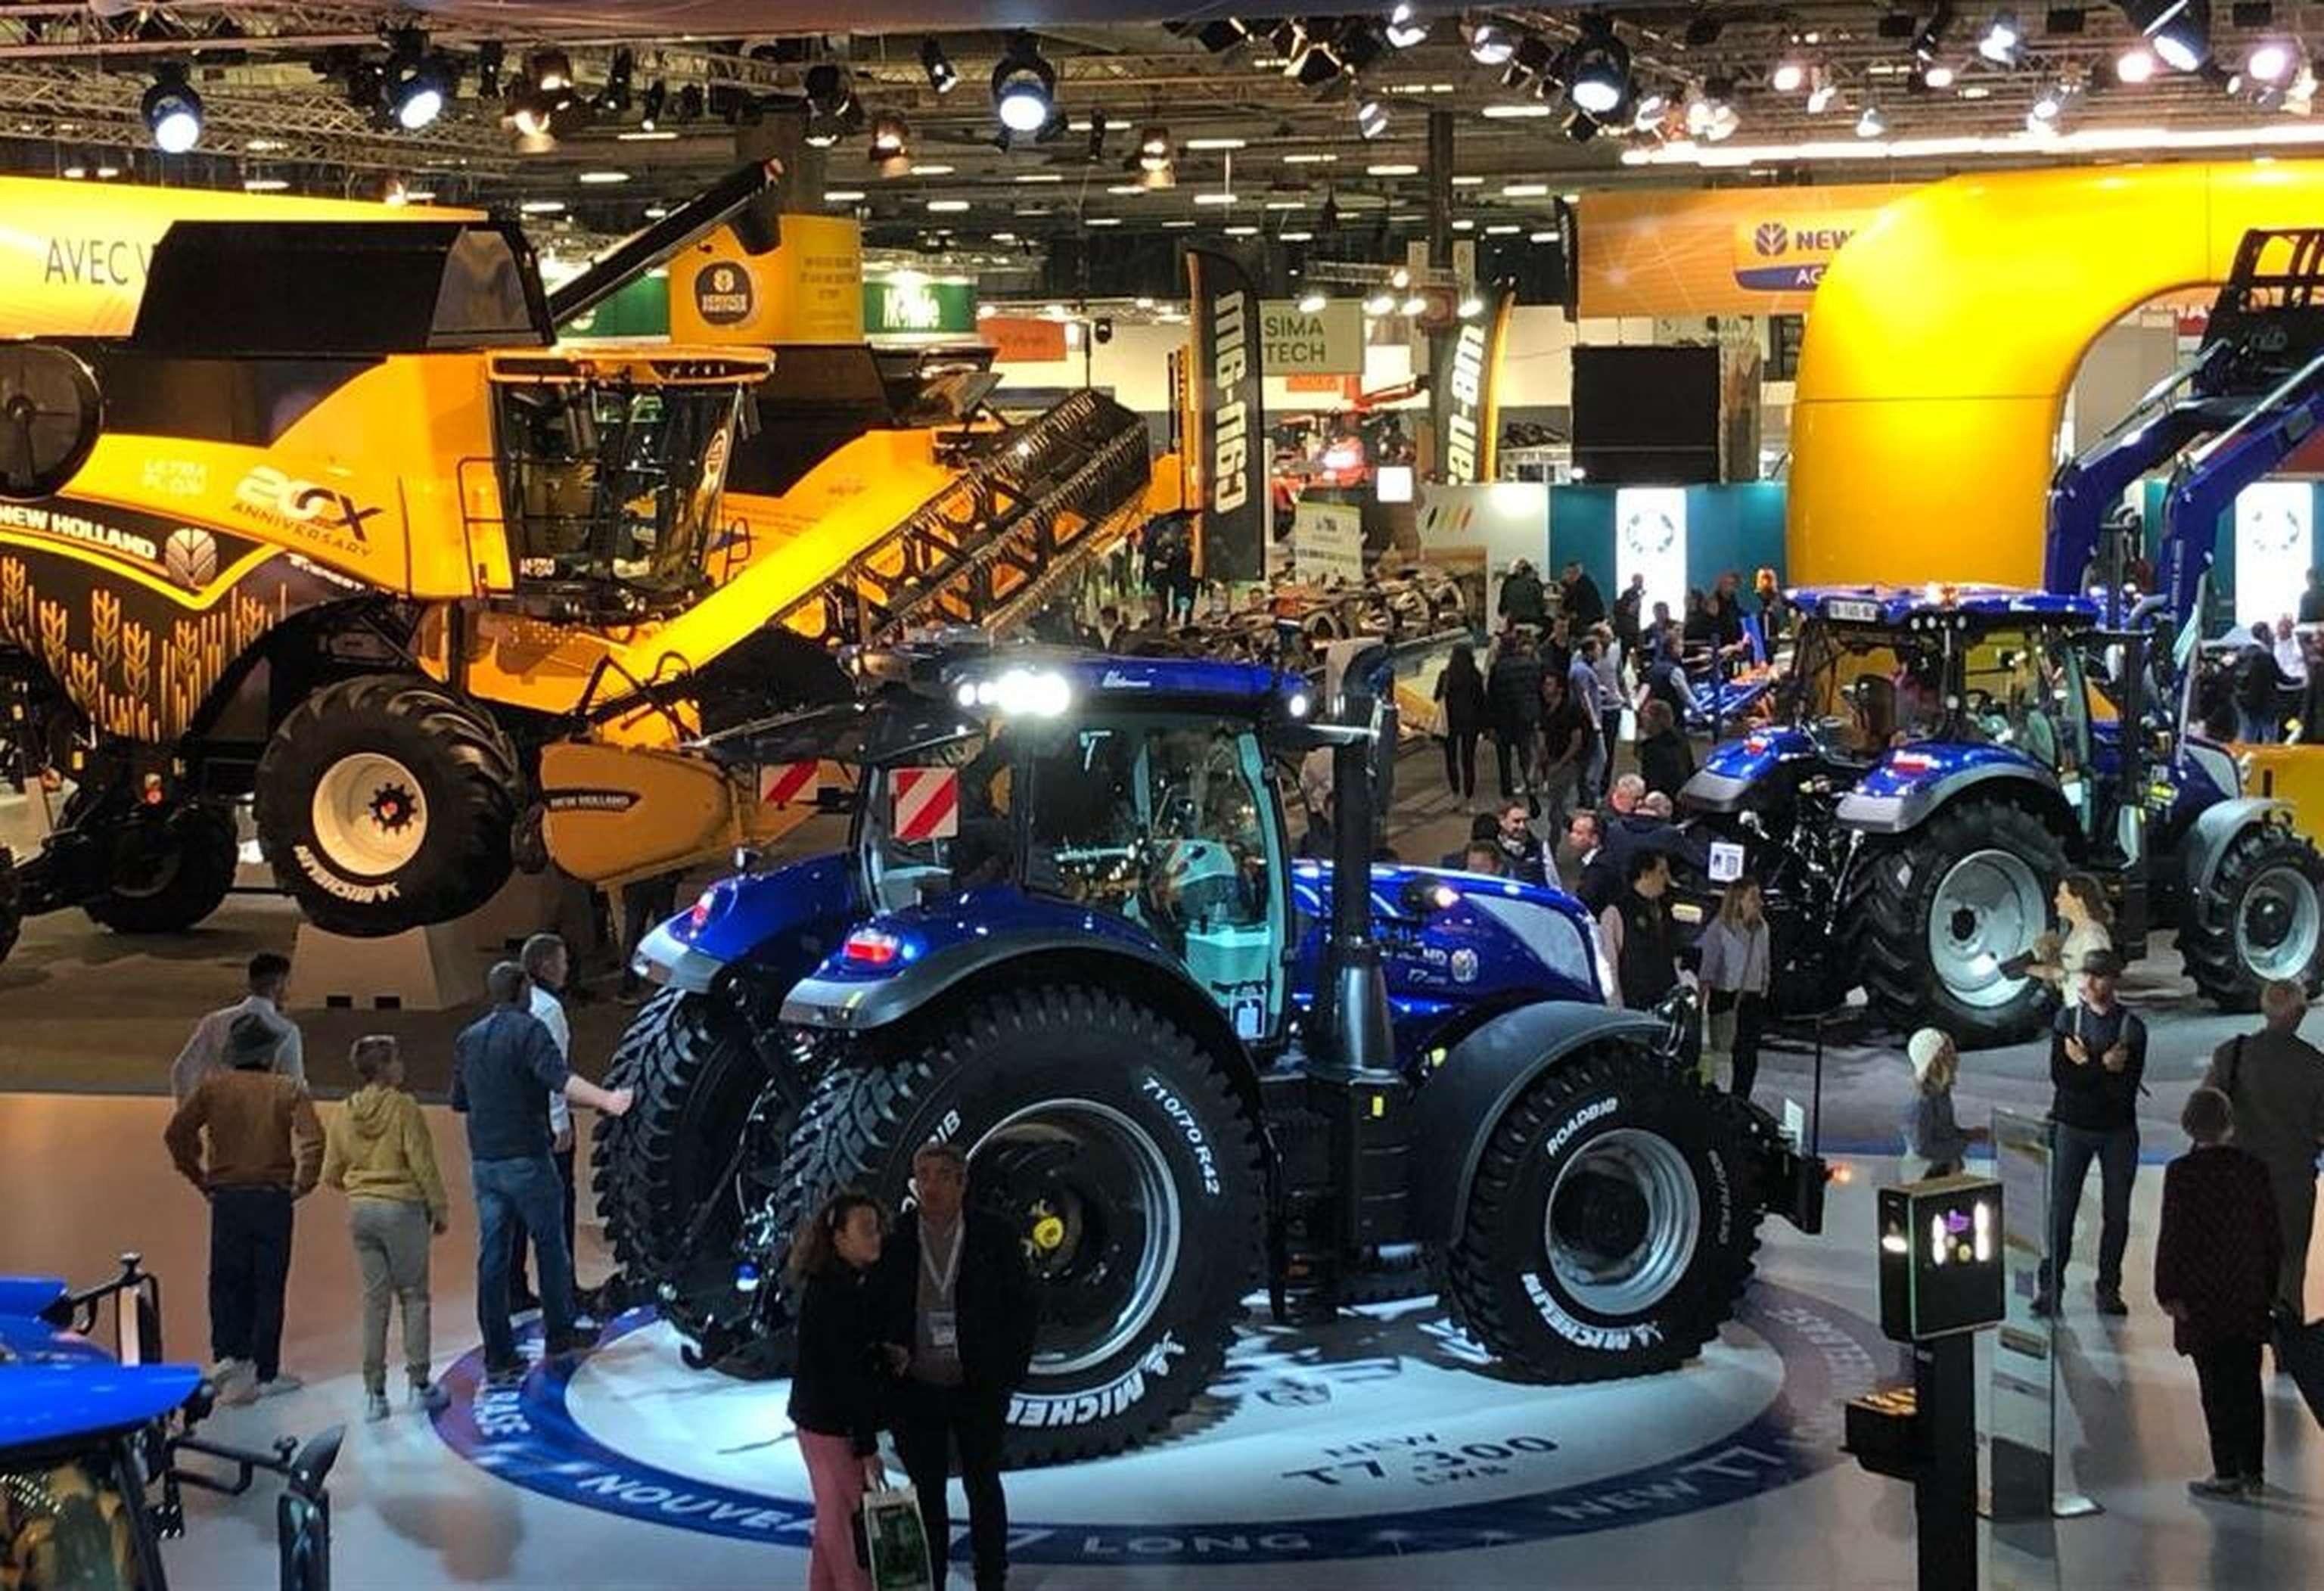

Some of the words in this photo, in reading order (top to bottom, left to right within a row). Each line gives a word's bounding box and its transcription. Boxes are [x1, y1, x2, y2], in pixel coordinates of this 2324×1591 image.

[45, 238, 129, 285] AVEC
[1796, 229, 1855, 251] NEW
[1264, 316, 1325, 337] SIMA
[1264, 342, 1326, 364] TECH
[1215, 291, 1247, 514] can-am
[1447, 325, 1486, 485] an-am
[0, 505, 48, 530] NEW
[51, 512, 157, 561] HOLLAND
[231, 502, 375, 558] ANNIVERSARY
[1521, 1273, 1631, 1351] MICHELIN
[576, 1474, 818, 1533] NOUVEA
[1547, 1477, 1701, 1521] NEW
[1082, 1532, 1312, 1555] LONG
